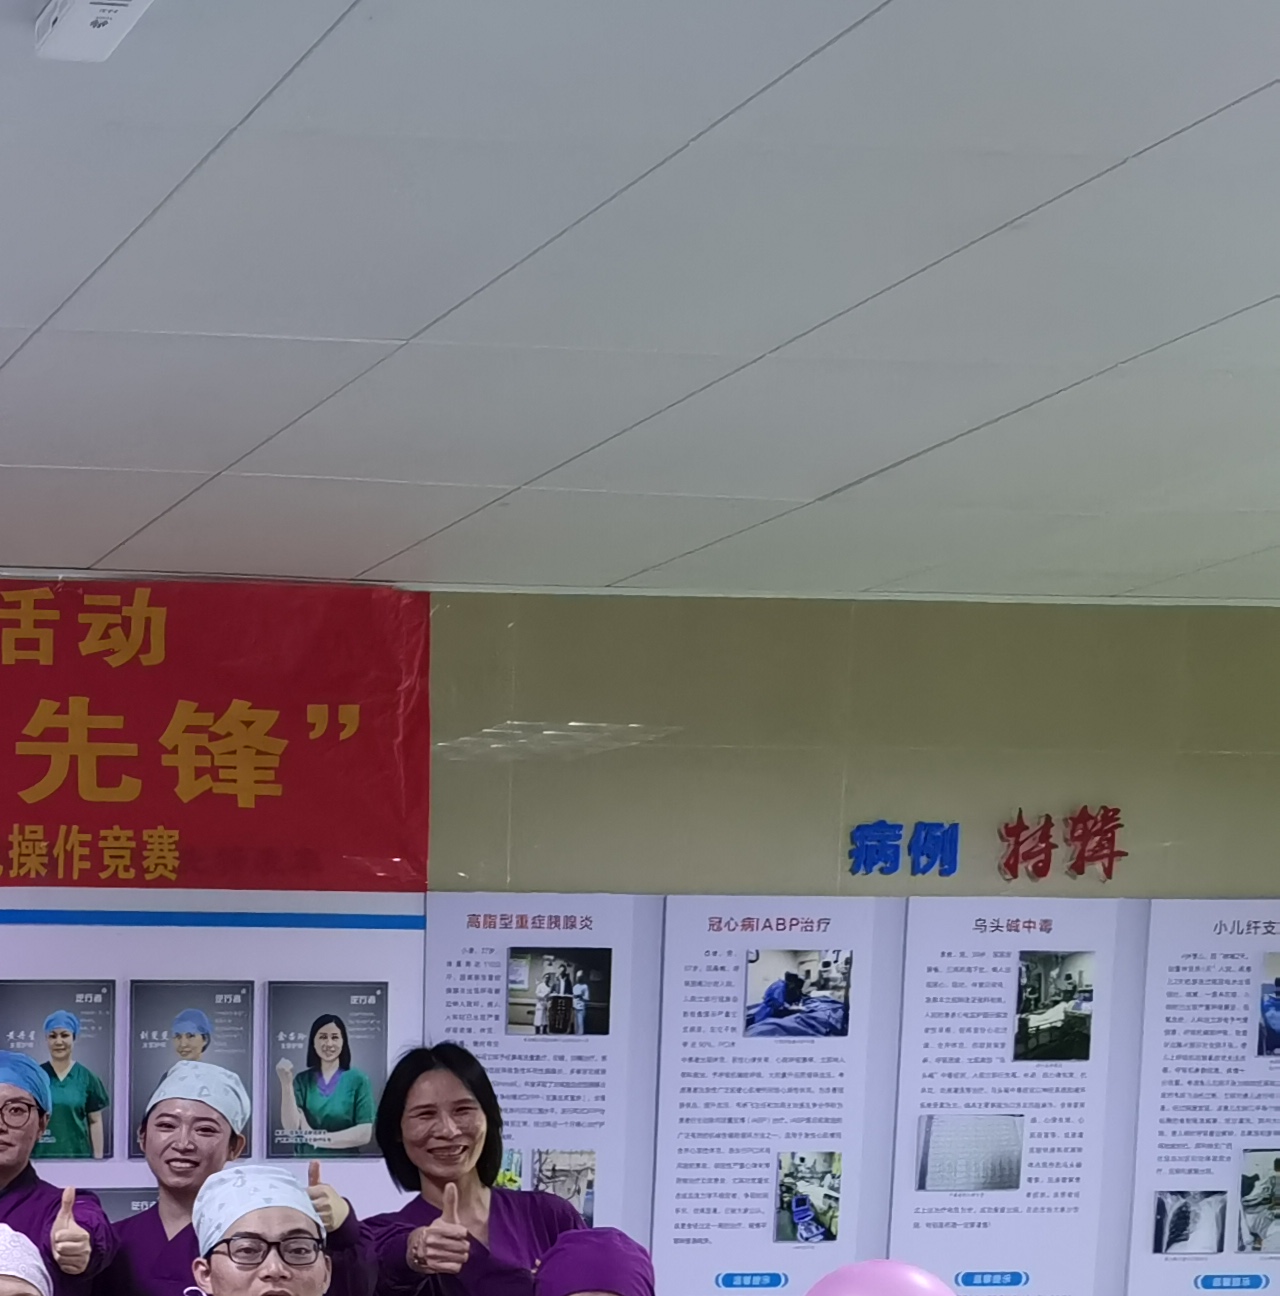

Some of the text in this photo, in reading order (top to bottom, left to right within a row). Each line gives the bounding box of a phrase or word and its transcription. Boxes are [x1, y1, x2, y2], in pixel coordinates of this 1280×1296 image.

[848, 820, 959, 876] 病例
[466, 913, 594, 931] 高脂型重症胰腺炎
[706, 916, 832, 933] 冠心病IABP治疗
[971, 917, 1054, 934] 乌头碱中毒
